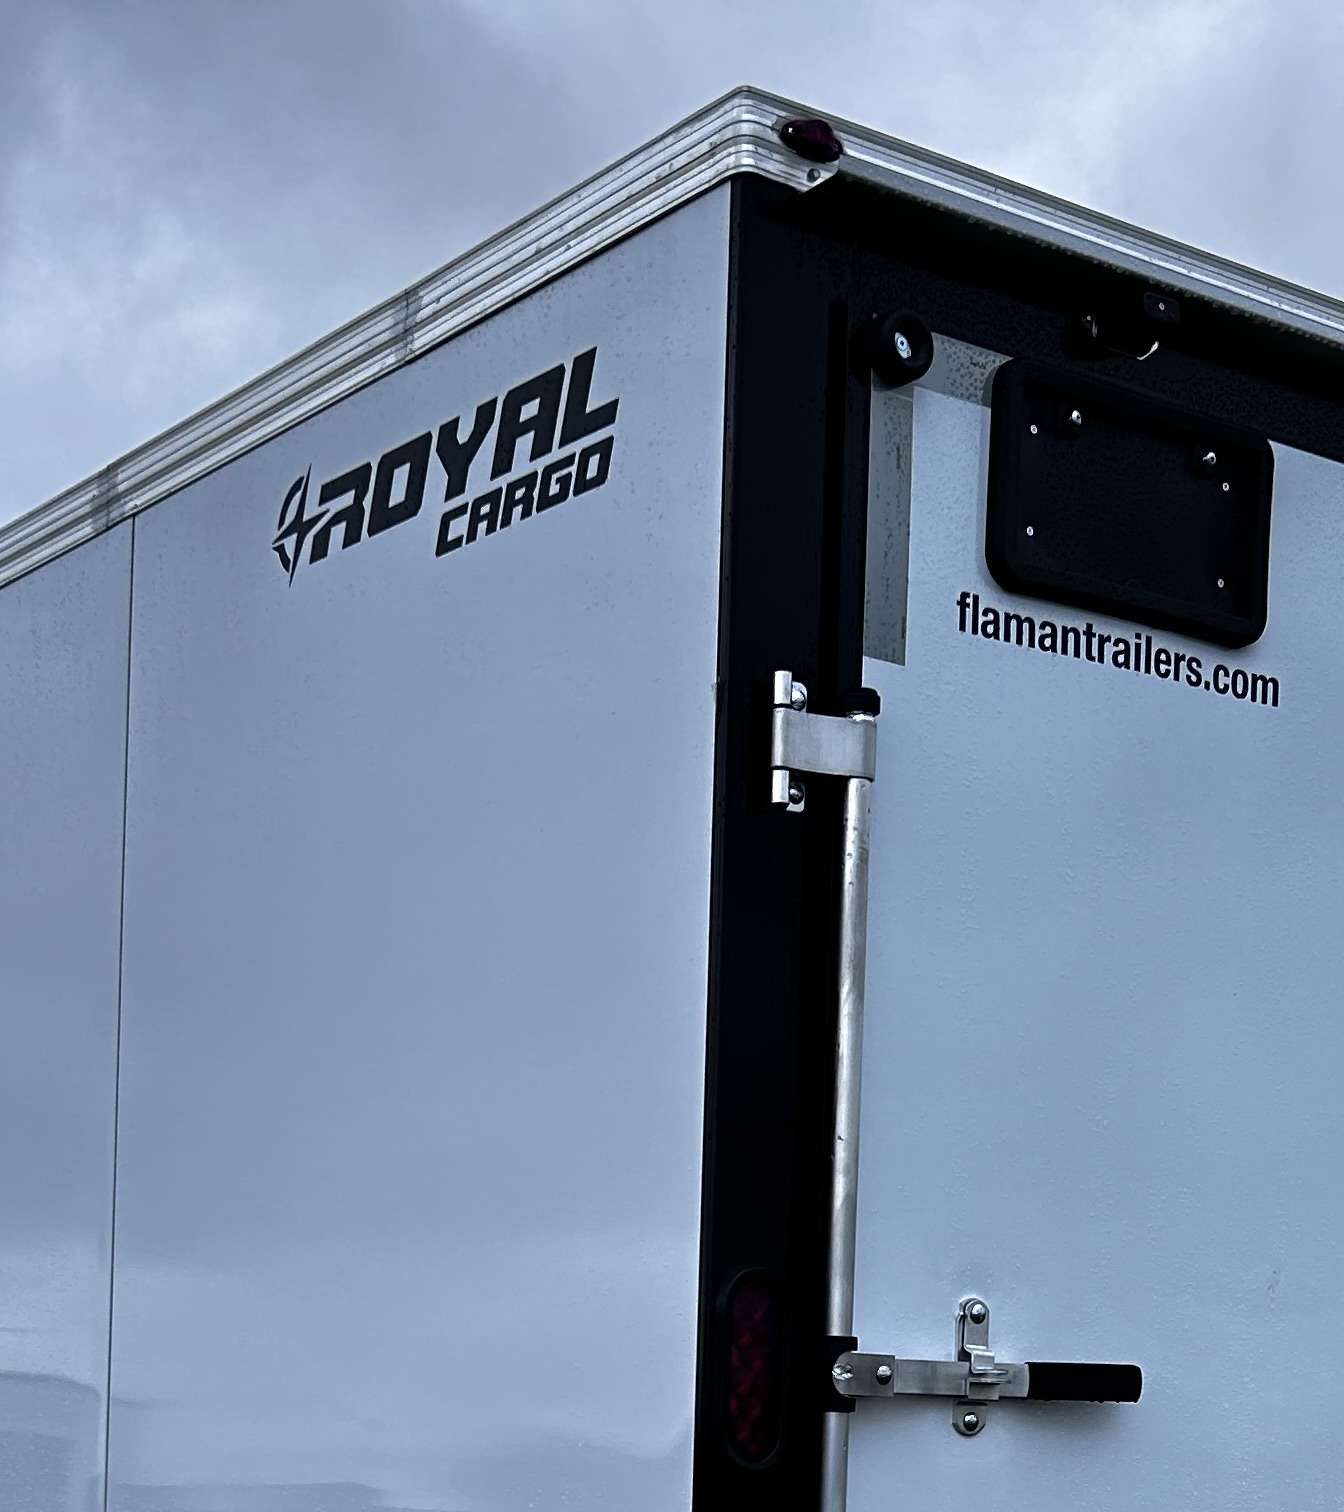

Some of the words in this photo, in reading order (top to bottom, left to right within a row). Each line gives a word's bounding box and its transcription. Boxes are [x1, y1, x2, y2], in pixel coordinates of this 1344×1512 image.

[309, 346, 620, 565] ROYAL
[435, 434, 615, 558] CARGO
[956, 590, 1280, 708] flamantrailers.com
